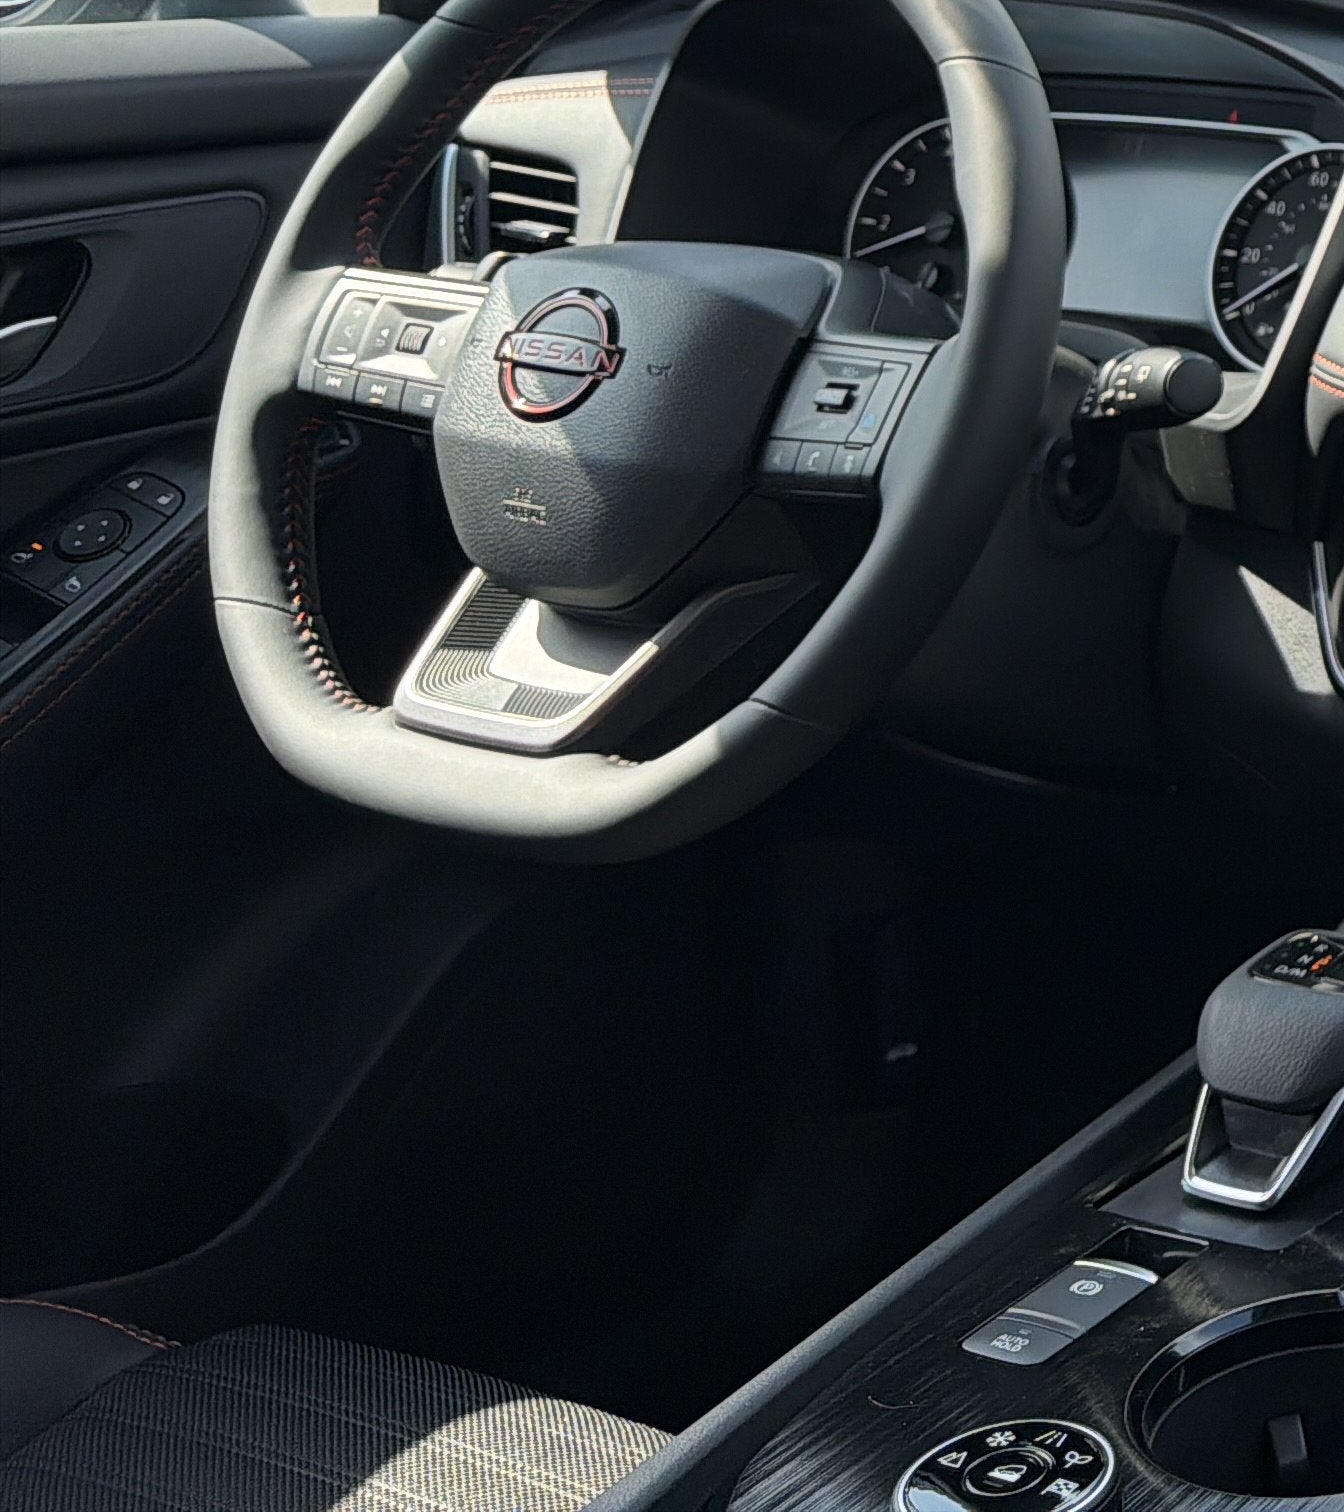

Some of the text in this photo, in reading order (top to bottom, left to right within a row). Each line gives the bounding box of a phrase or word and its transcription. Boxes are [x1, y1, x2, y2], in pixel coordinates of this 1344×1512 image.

[1310, 172, 1329, 187] 60
[1266, 201, 1286, 216] 40
[1240, 247, 1260, 264] 20
[501, 334, 620, 374] NISSAN
[990, 1340, 1021, 1352] HOLD
[997, 1333, 1030, 1346] AUTO
